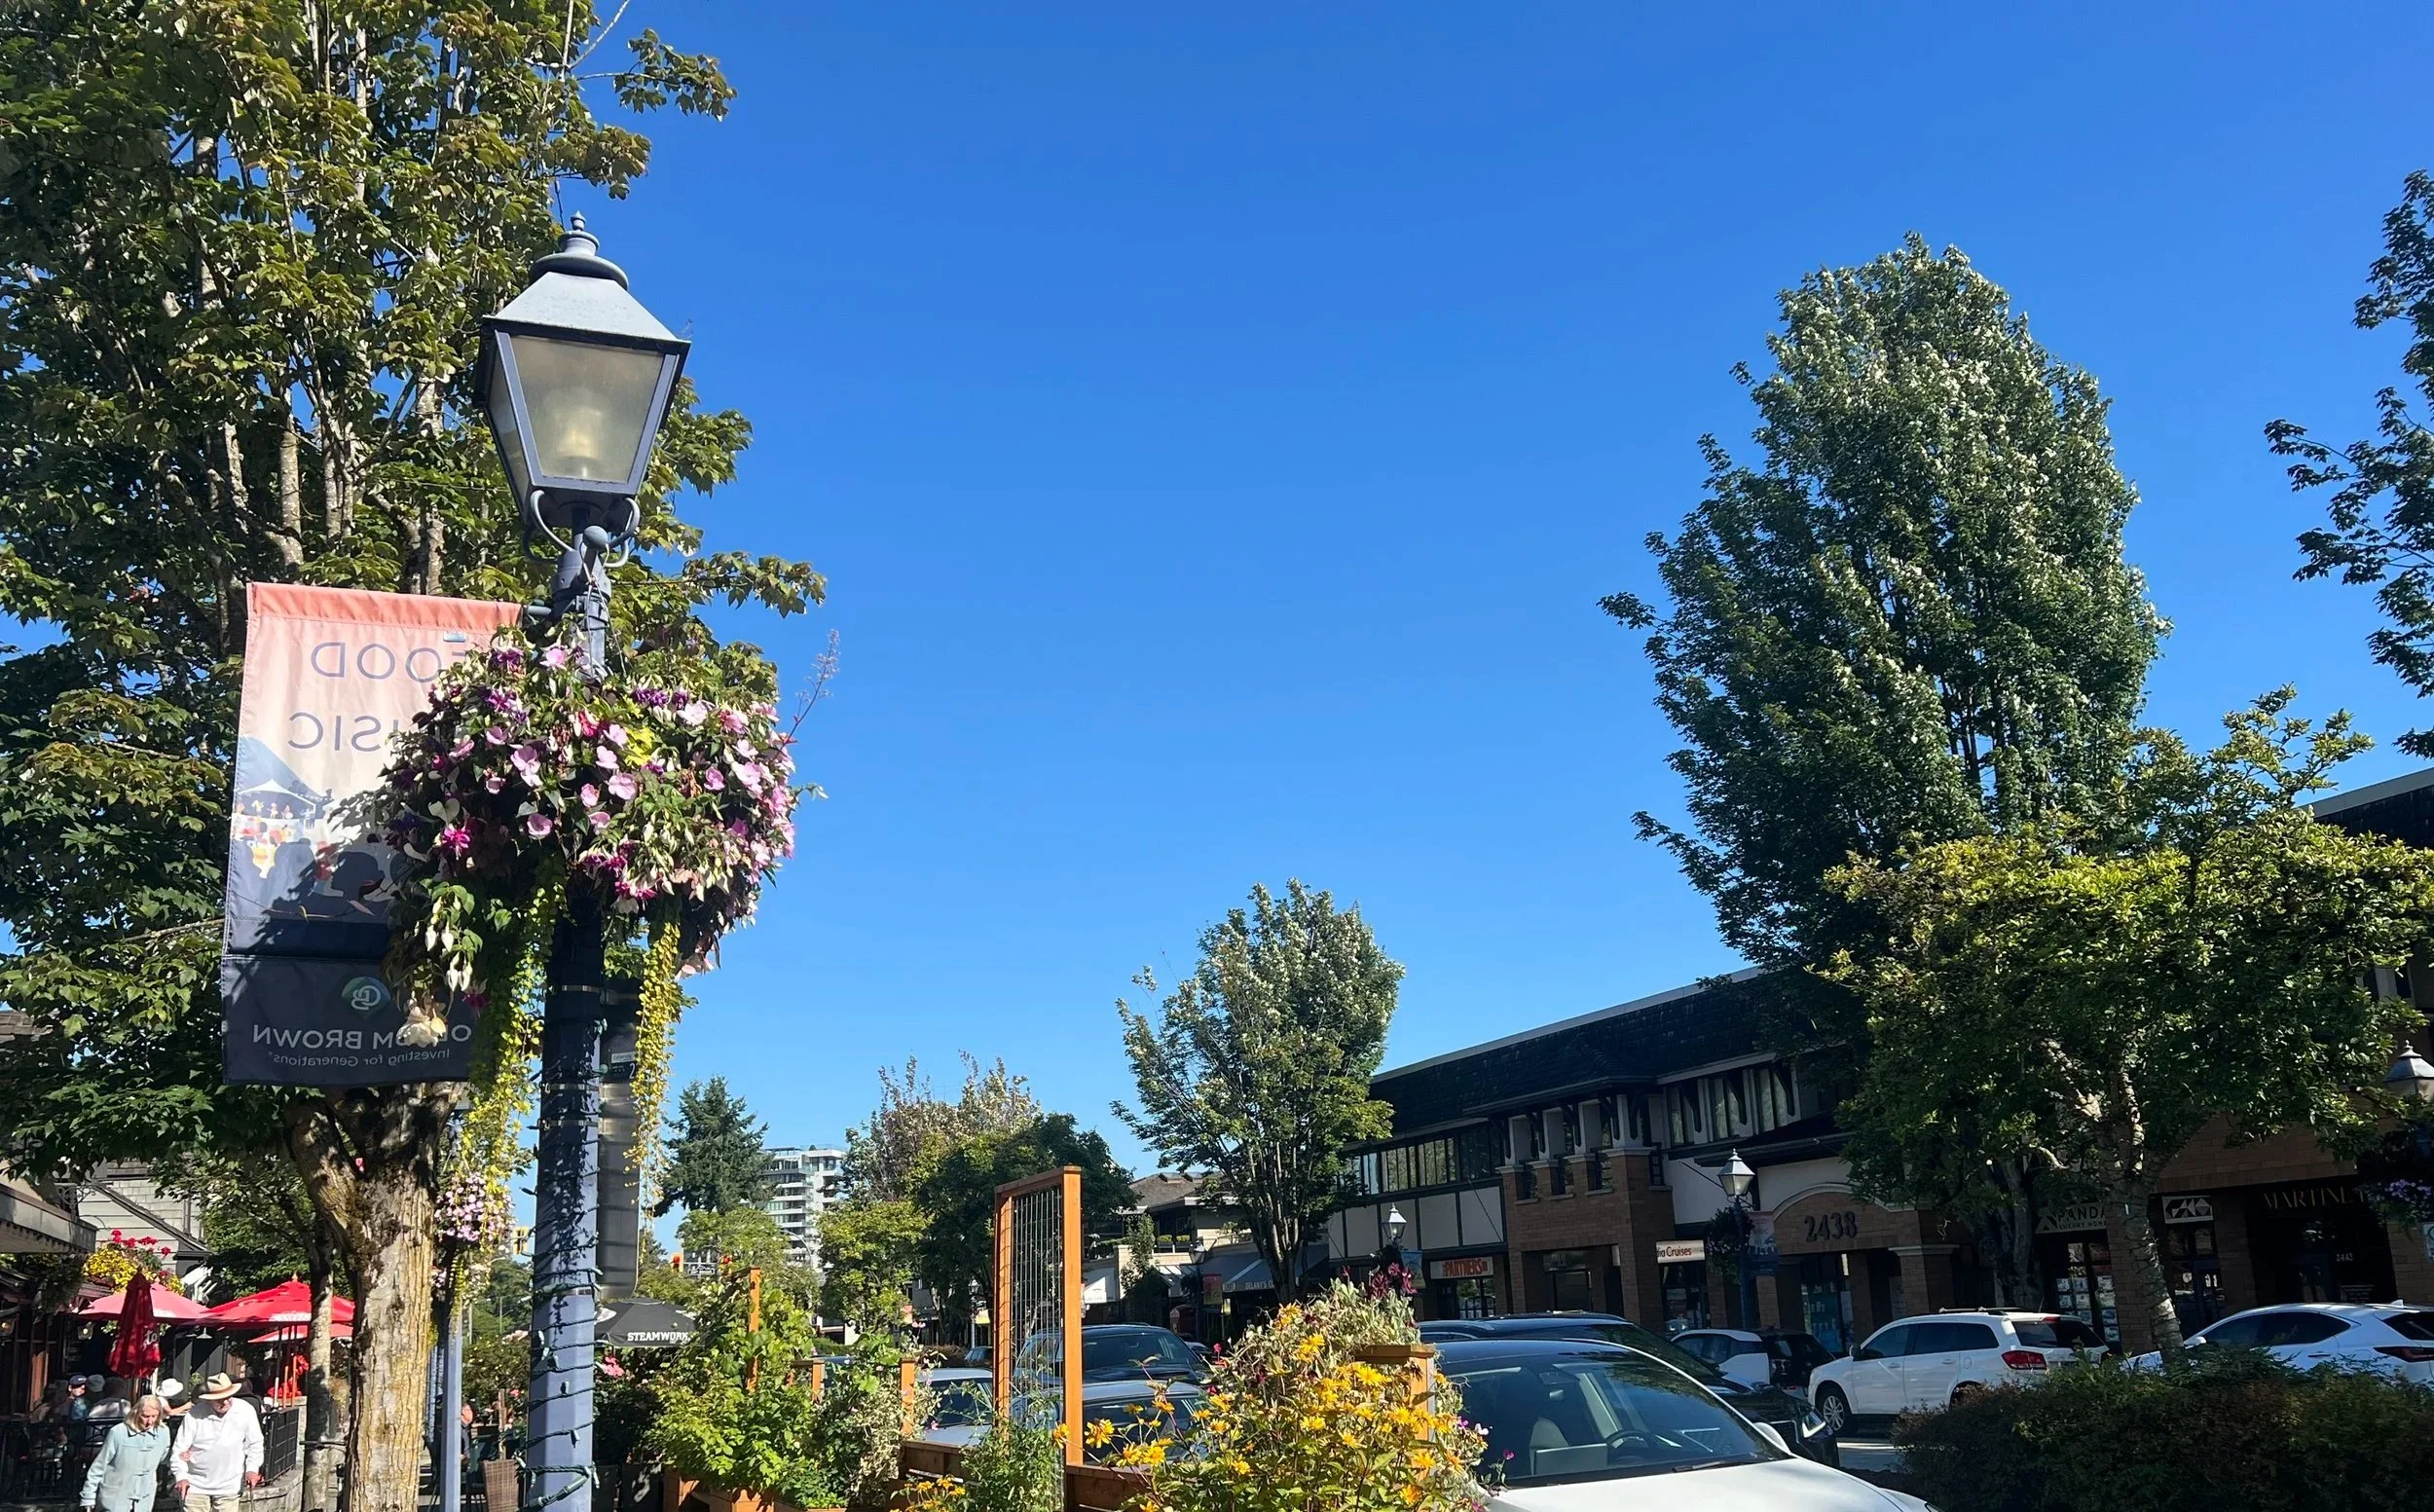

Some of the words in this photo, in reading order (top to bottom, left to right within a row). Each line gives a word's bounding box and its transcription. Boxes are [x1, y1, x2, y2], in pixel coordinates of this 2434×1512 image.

[1804, 1211, 1858, 1242] 2438
[1666, 1245, 1692, 1257] Cruises
[627, 1331, 691, 1343] STEAMWORK
